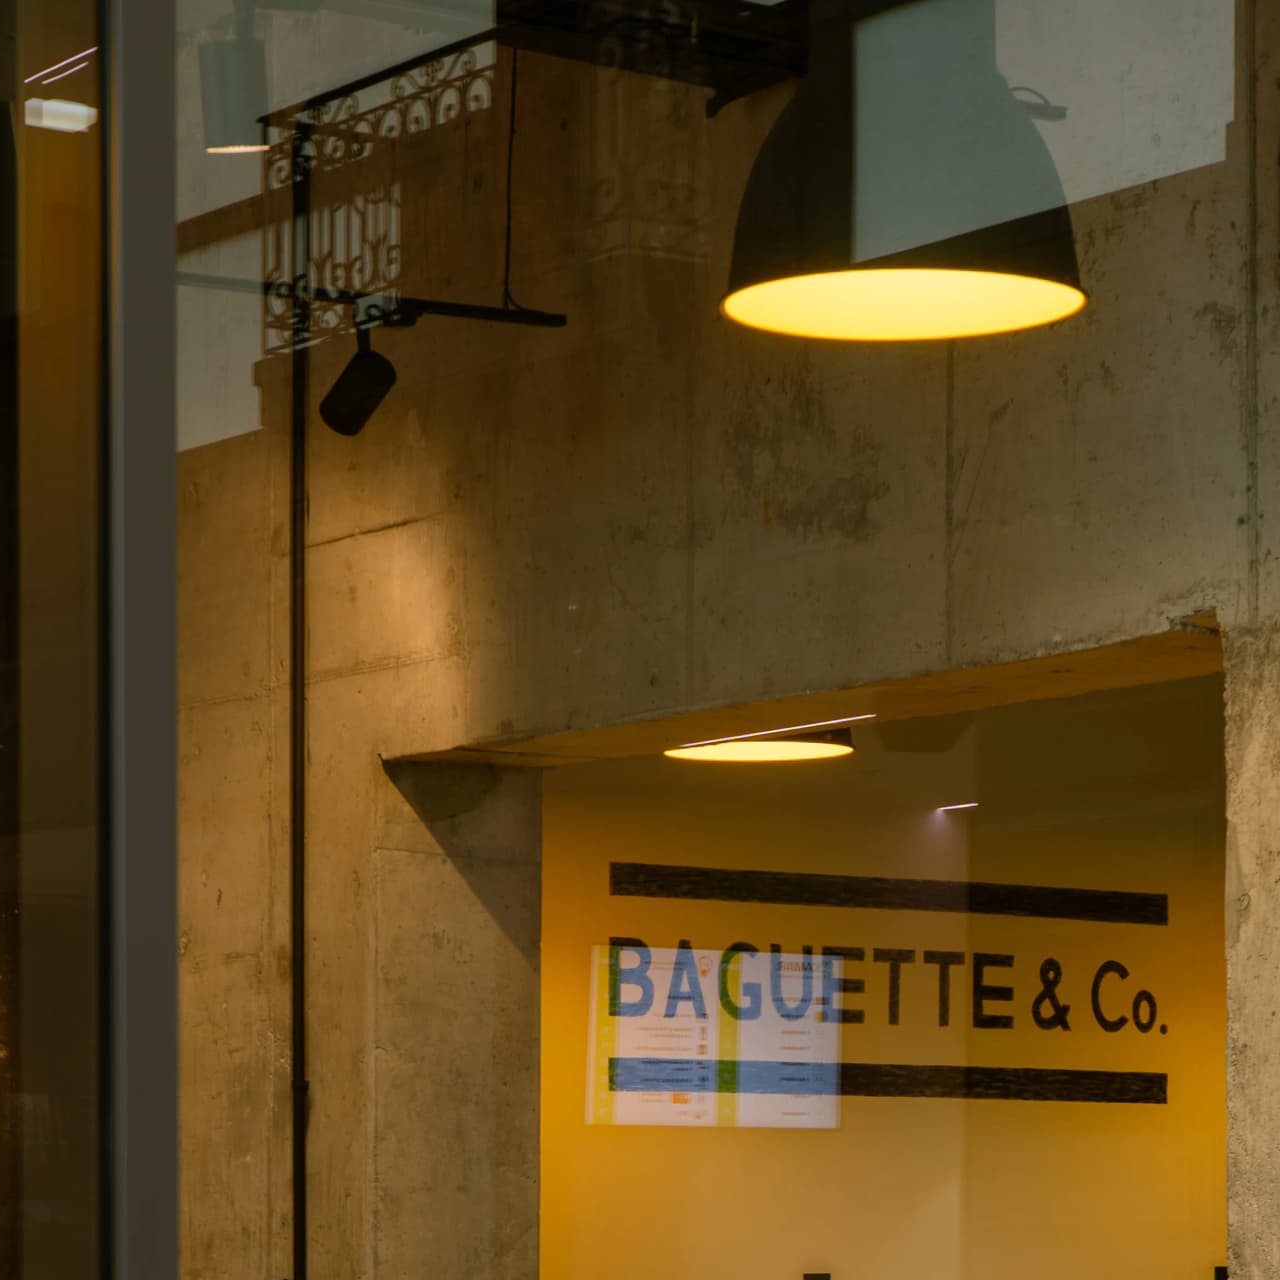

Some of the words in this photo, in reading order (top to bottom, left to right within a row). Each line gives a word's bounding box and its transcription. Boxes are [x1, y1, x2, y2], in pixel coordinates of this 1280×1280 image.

[609, 936, 1015, 1029] BAGUETTE
[1032, 957, 1071, 1032] &
[1091, 960, 1169, 1035] Co.
